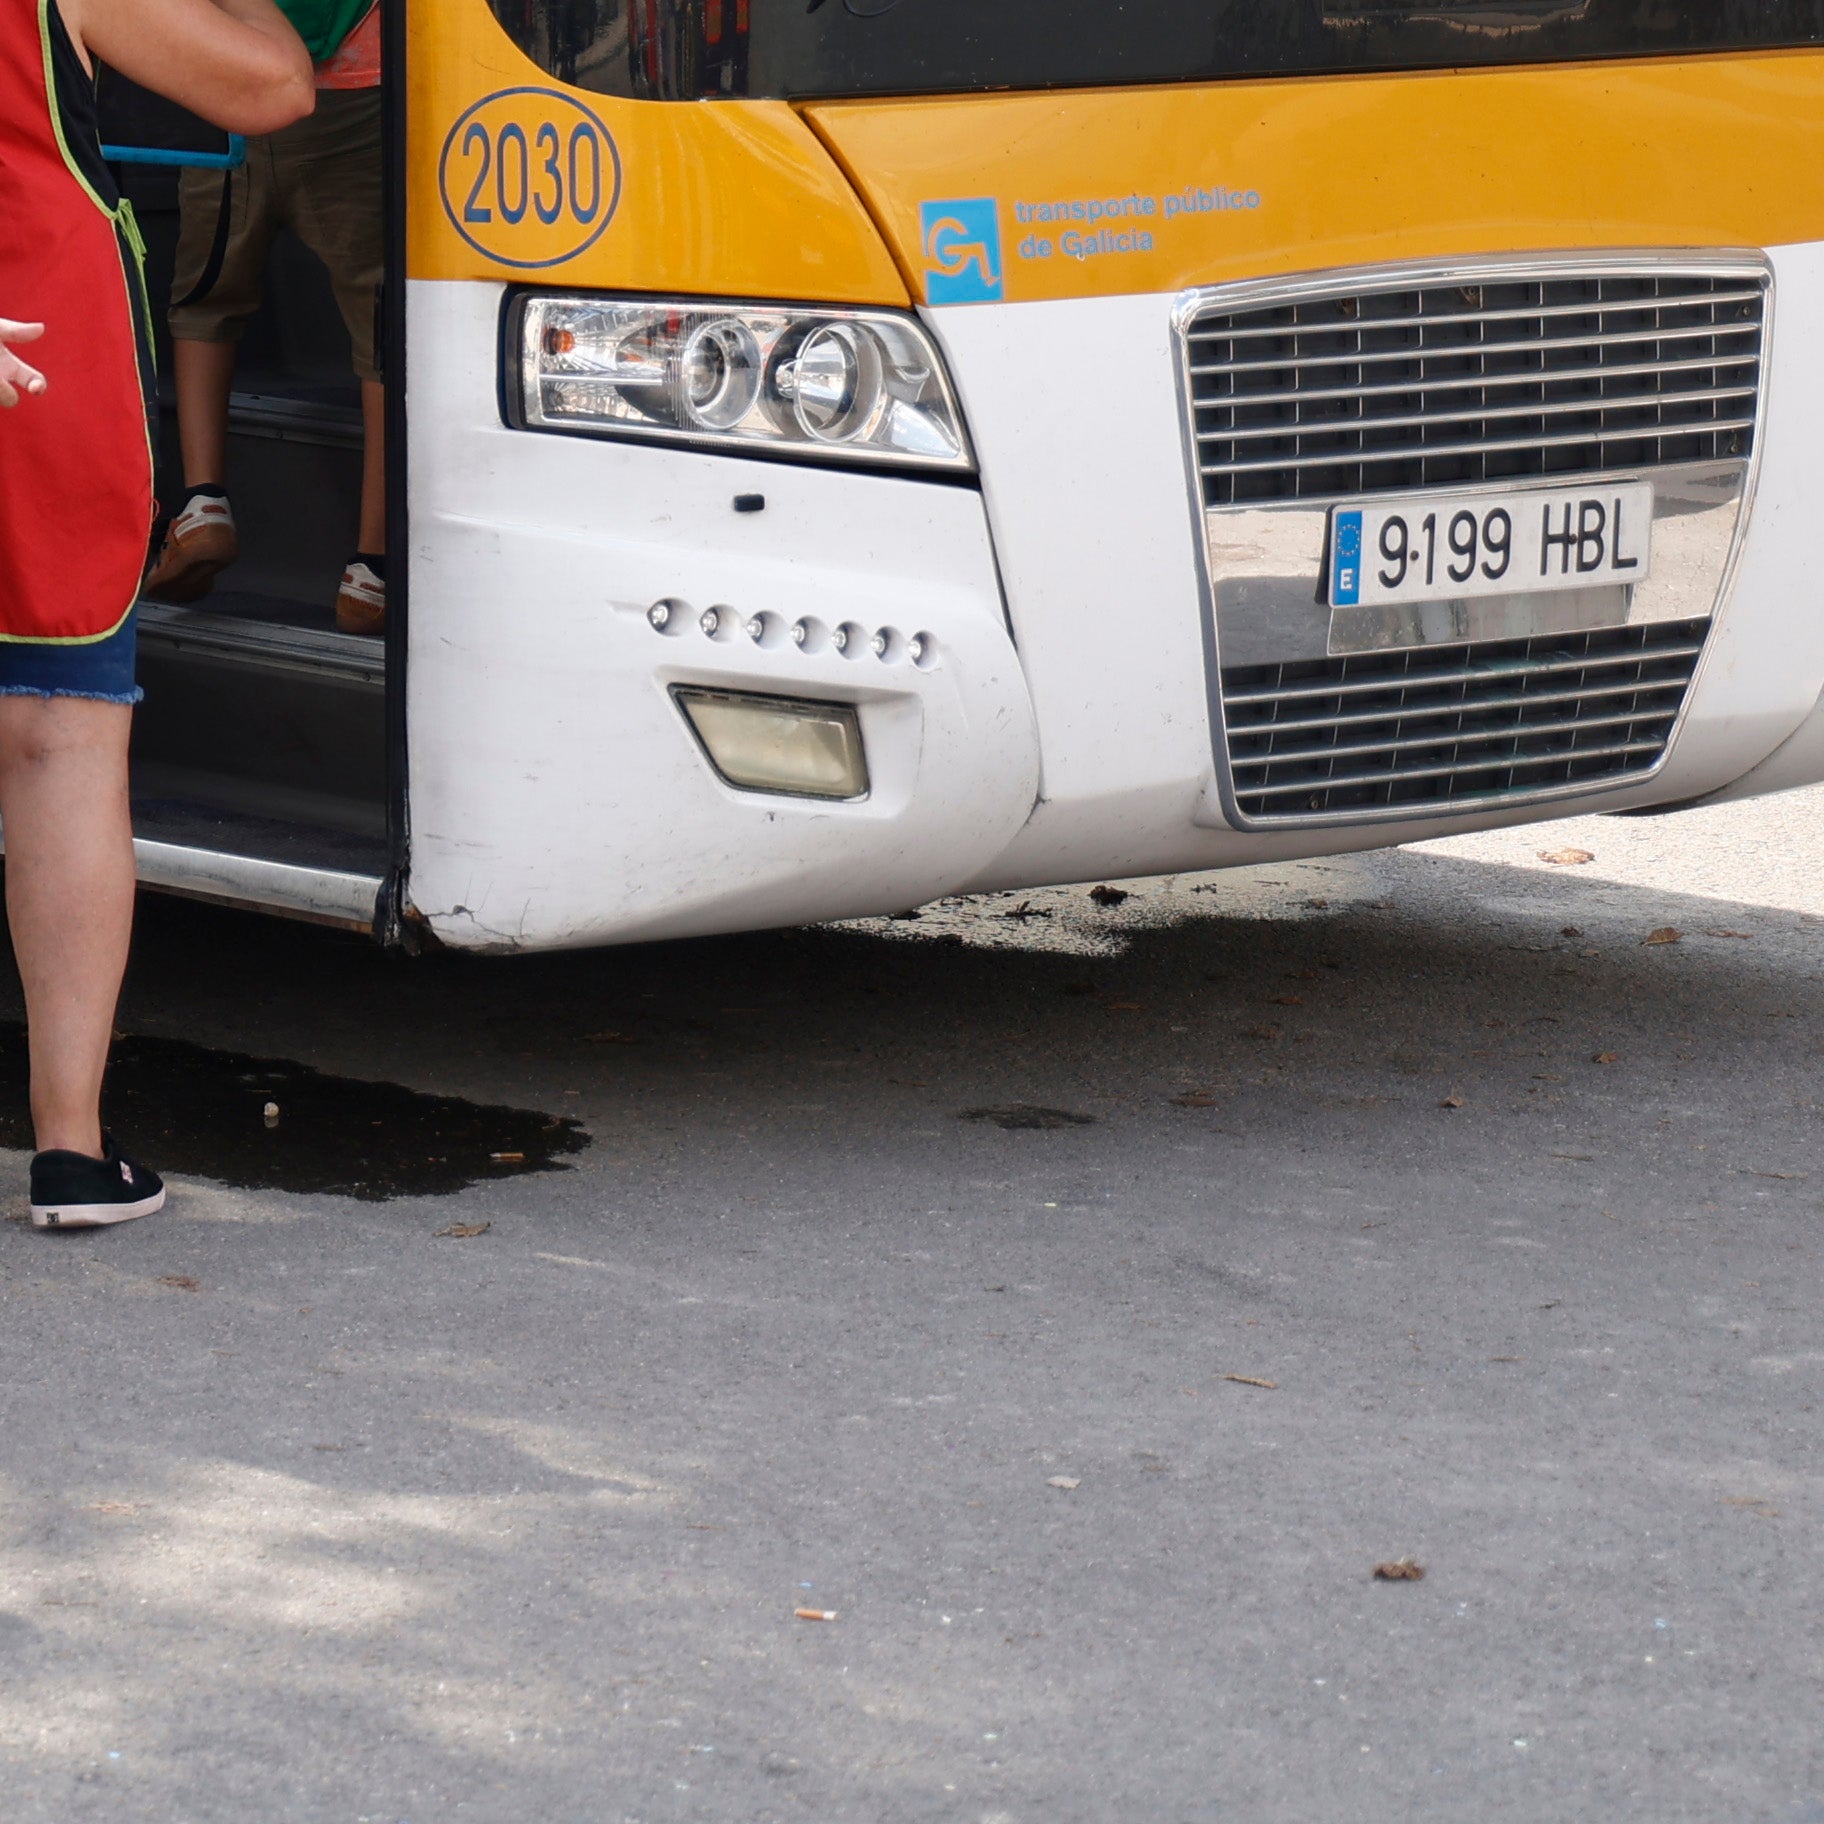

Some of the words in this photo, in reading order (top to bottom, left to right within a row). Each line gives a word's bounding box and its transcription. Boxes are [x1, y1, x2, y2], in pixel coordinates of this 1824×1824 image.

[461, 121, 601, 225] 2030
[1015, 195, 1156, 225] transporte
[1163, 185, 1262, 220] público
[1018, 234, 1053, 259] de
[1060, 228, 1154, 257] Galicia
[1377, 506, 1513, 589] 9199
[1539, 496, 1639, 577] HBL
[1340, 568, 1354, 590] E
